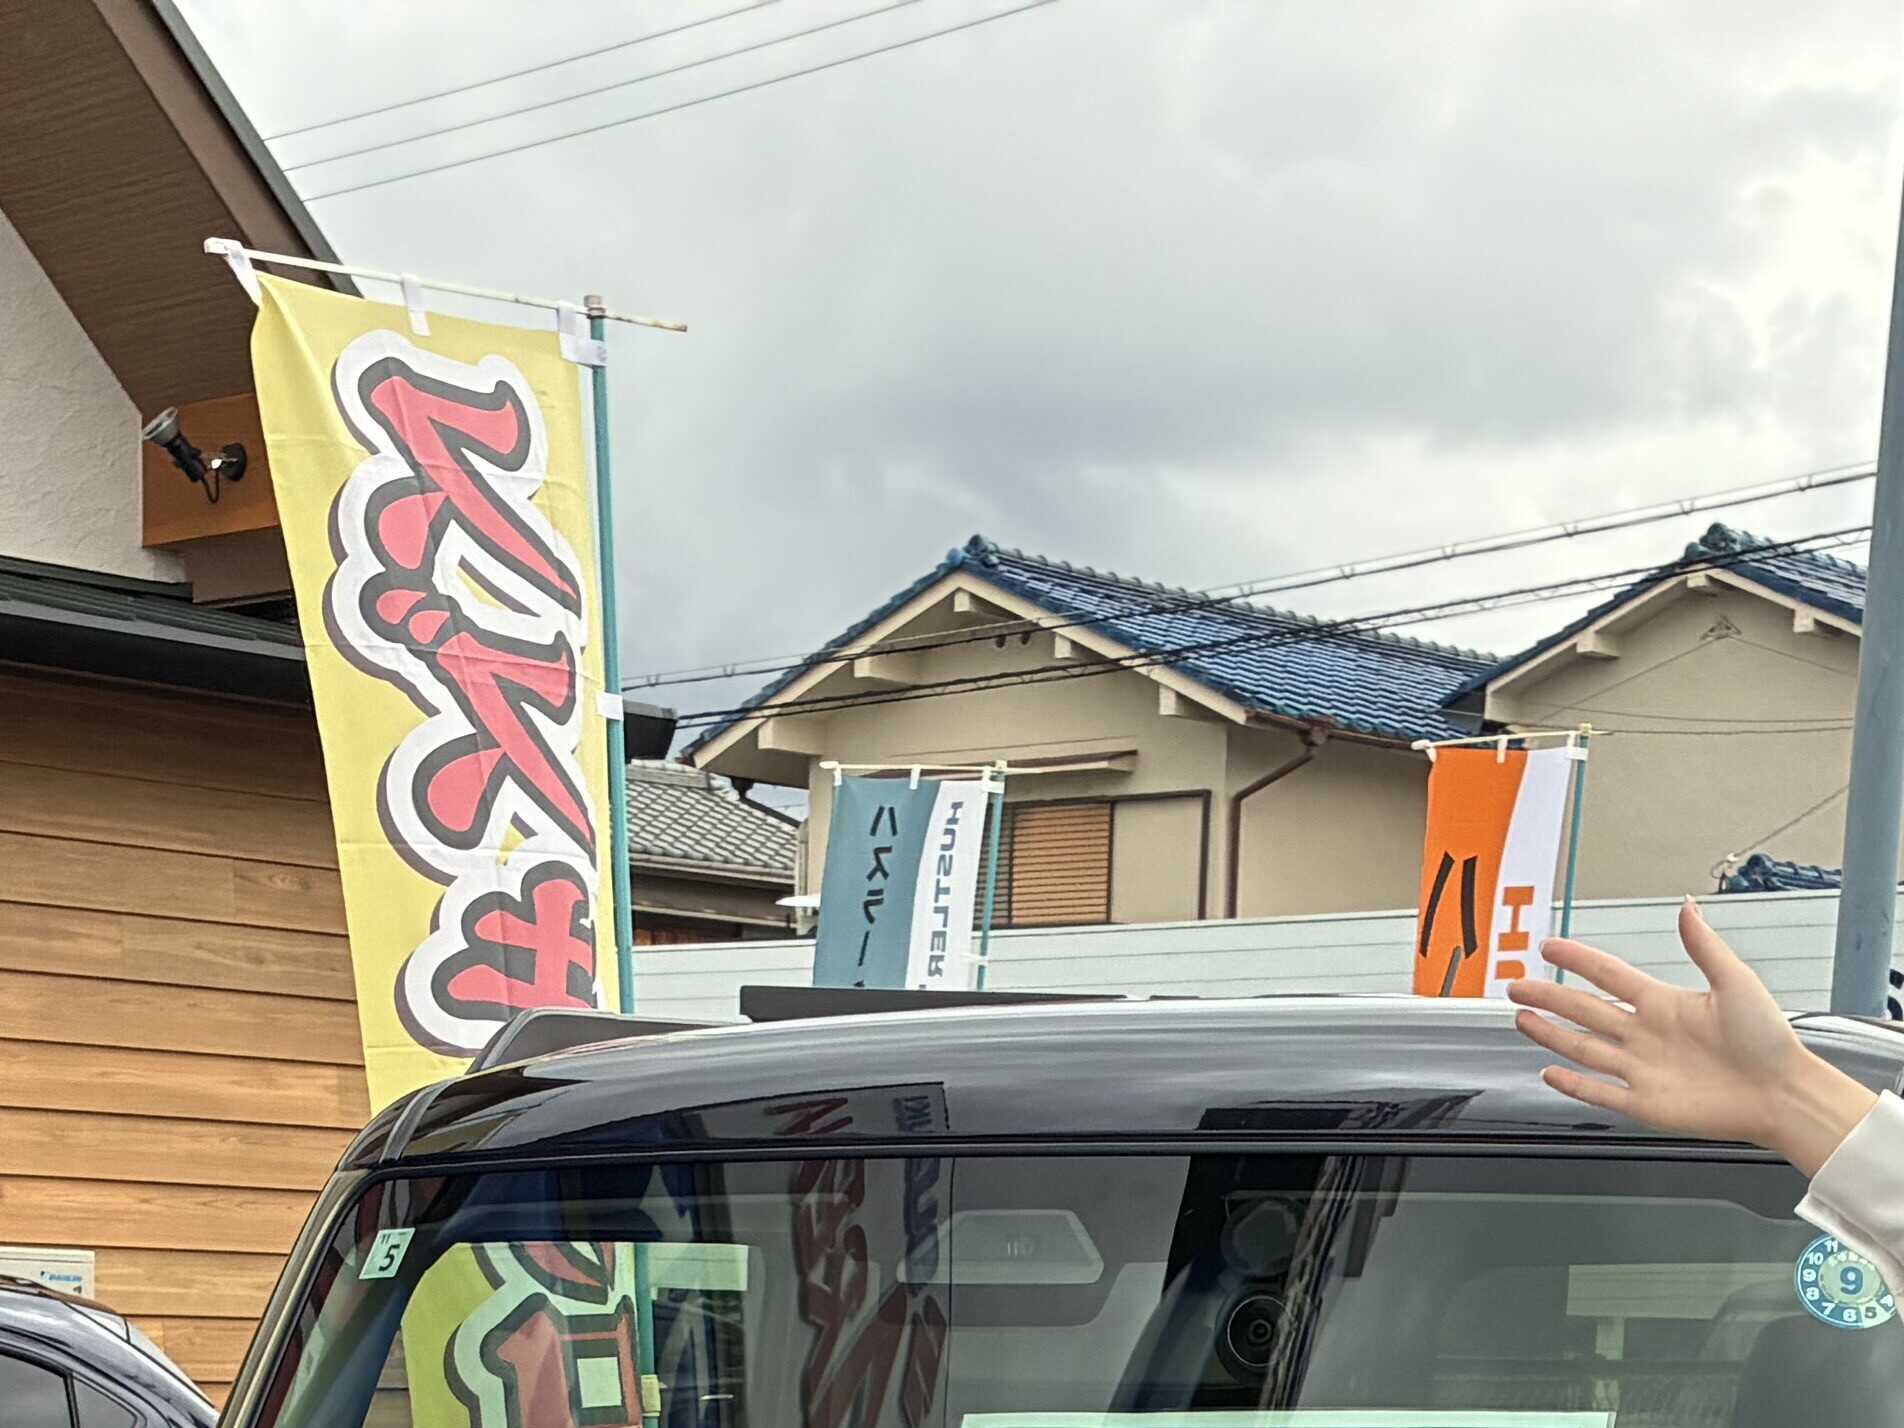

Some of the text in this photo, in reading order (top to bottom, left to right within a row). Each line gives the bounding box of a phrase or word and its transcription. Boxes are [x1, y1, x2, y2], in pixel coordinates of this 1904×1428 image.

[378, 1243, 401, 1272] 5
[1807, 1252, 1824, 1265] 10
[1802, 1268, 1817, 1282] 9
[1839, 1265, 1864, 1296] 9
[1806, 1287, 1820, 1301] 8
[1821, 1302, 1836, 1316] 7
[1842, 1308, 1857, 1323] 6
[1864, 1306, 1878, 1319] 5
